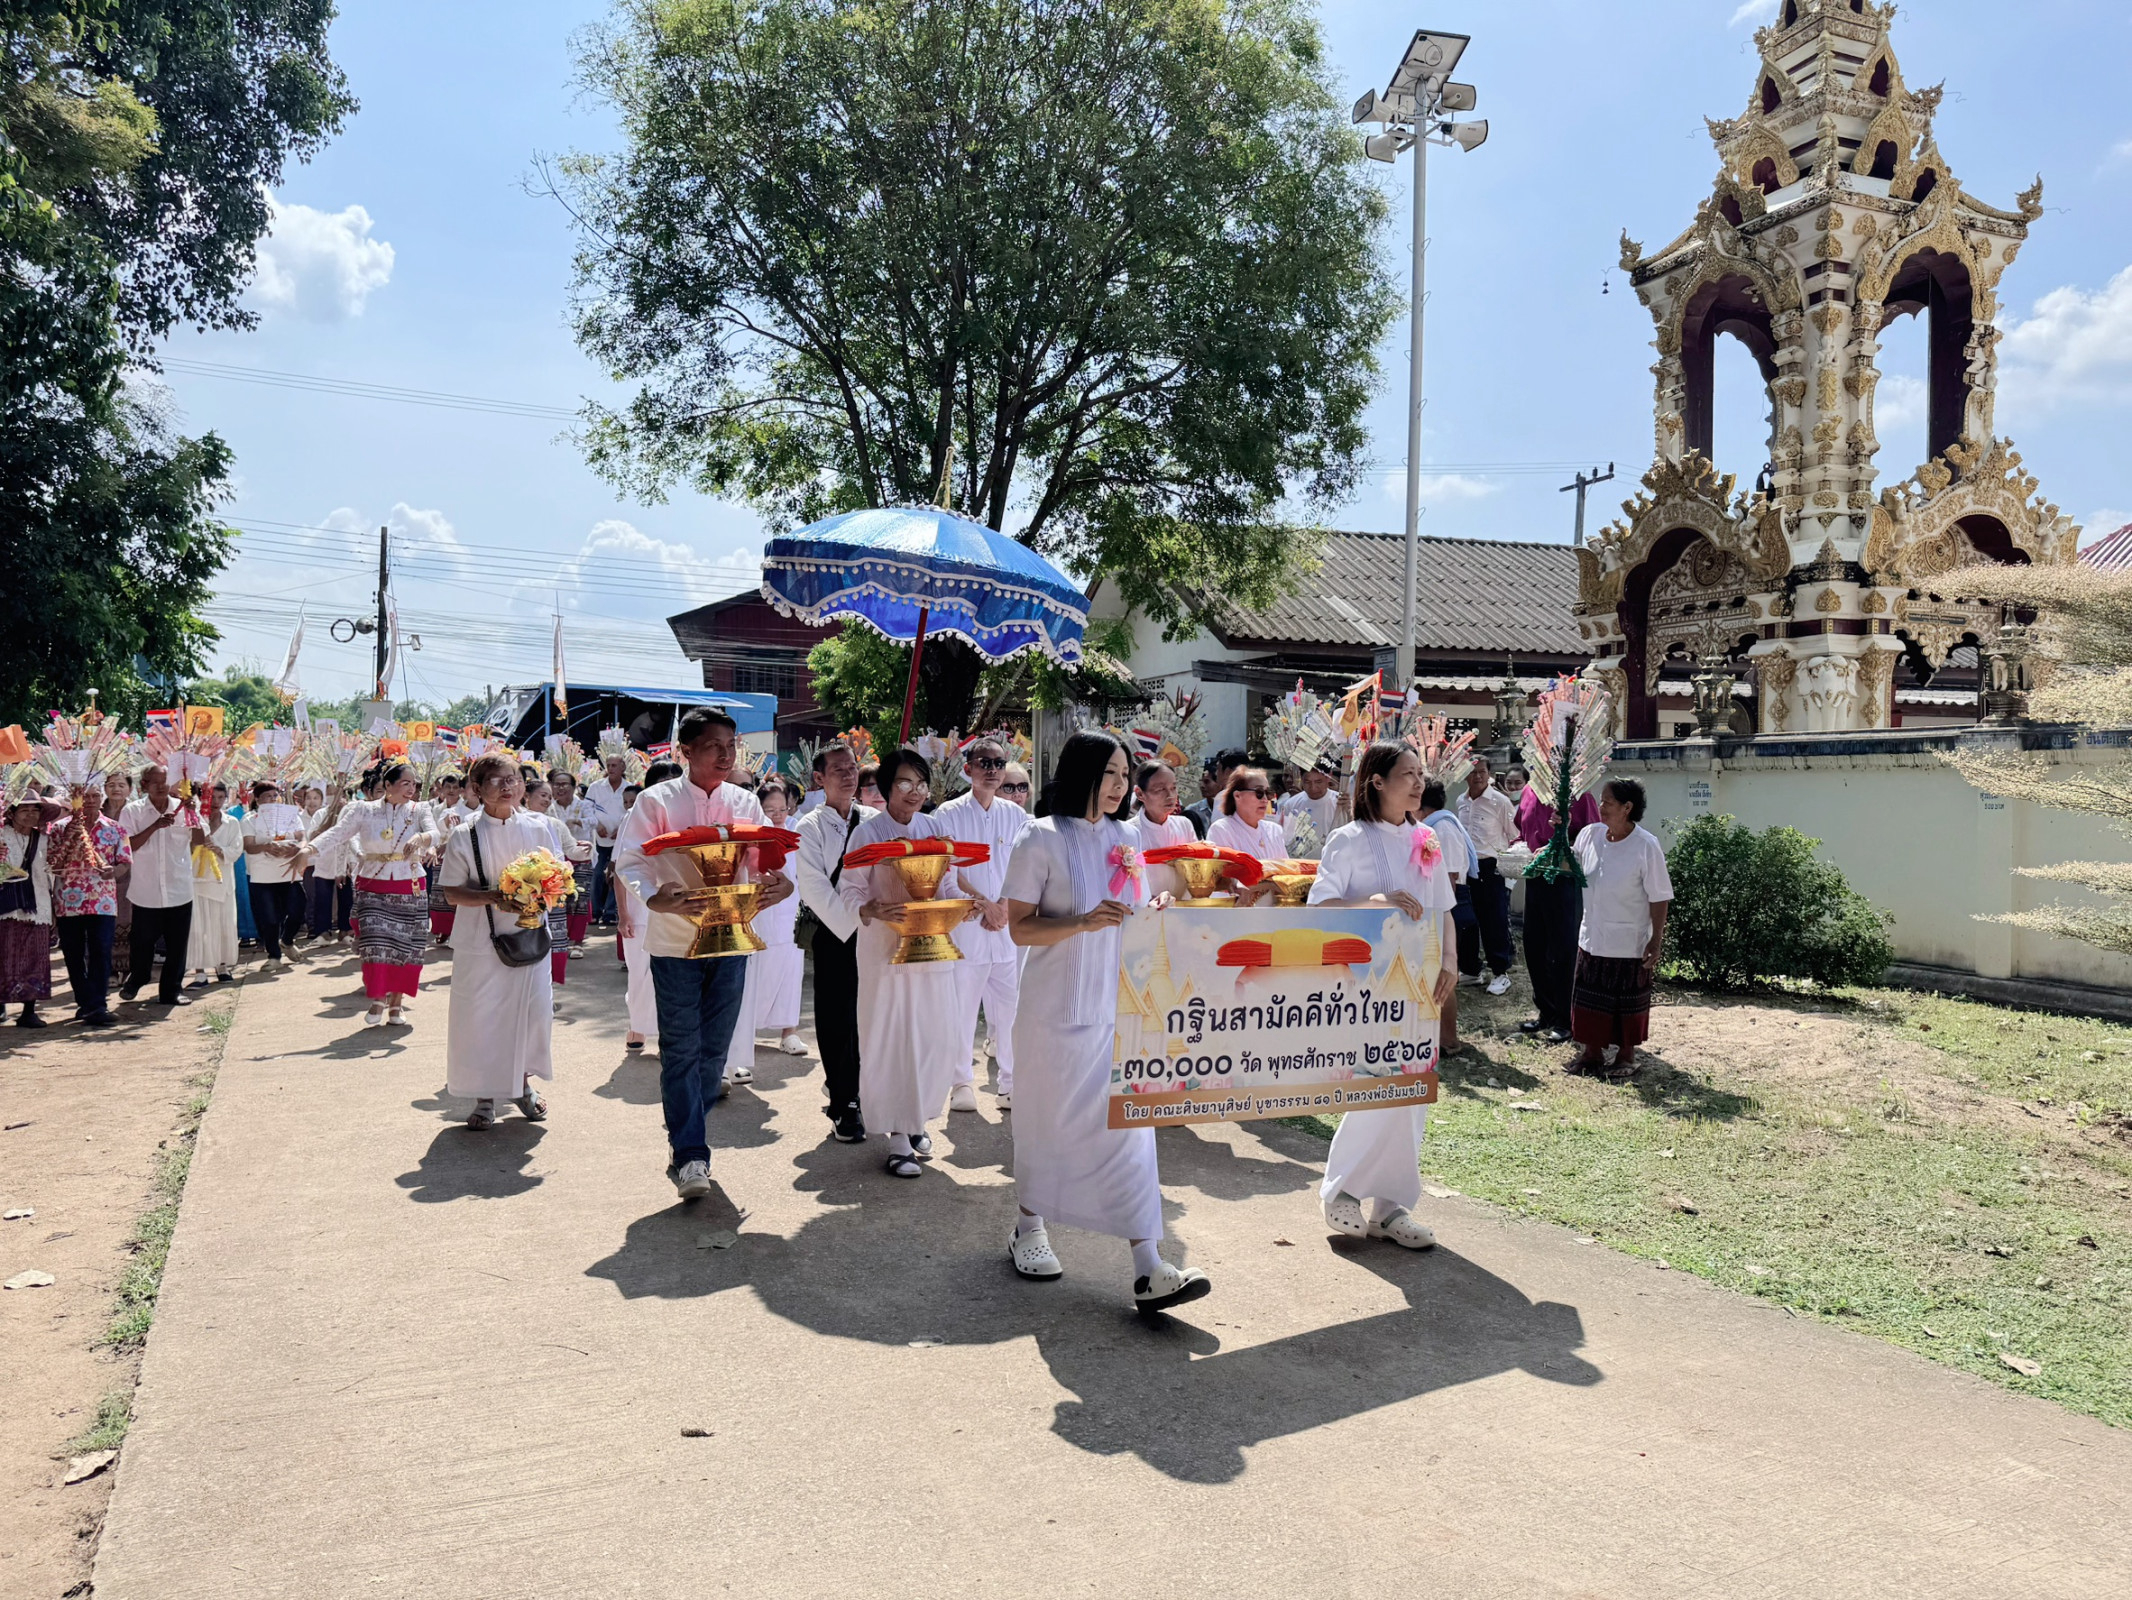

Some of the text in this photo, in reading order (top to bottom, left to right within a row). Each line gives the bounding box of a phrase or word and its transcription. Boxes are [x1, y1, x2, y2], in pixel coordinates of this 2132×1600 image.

[1167, 981, 1405, 1044] กฐินสามัคคีทั่วไทย
[1124, 1038, 1432, 1083] ๓๐,๐๐๐ วัด พุทธศักราช ๒๕๖๘
[1123, 1084, 1428, 1119] โดย คณะศิษยานุศิษย์ บูชาธรรม ๘๑ ปี หลวงพ่อธัมมชโย
